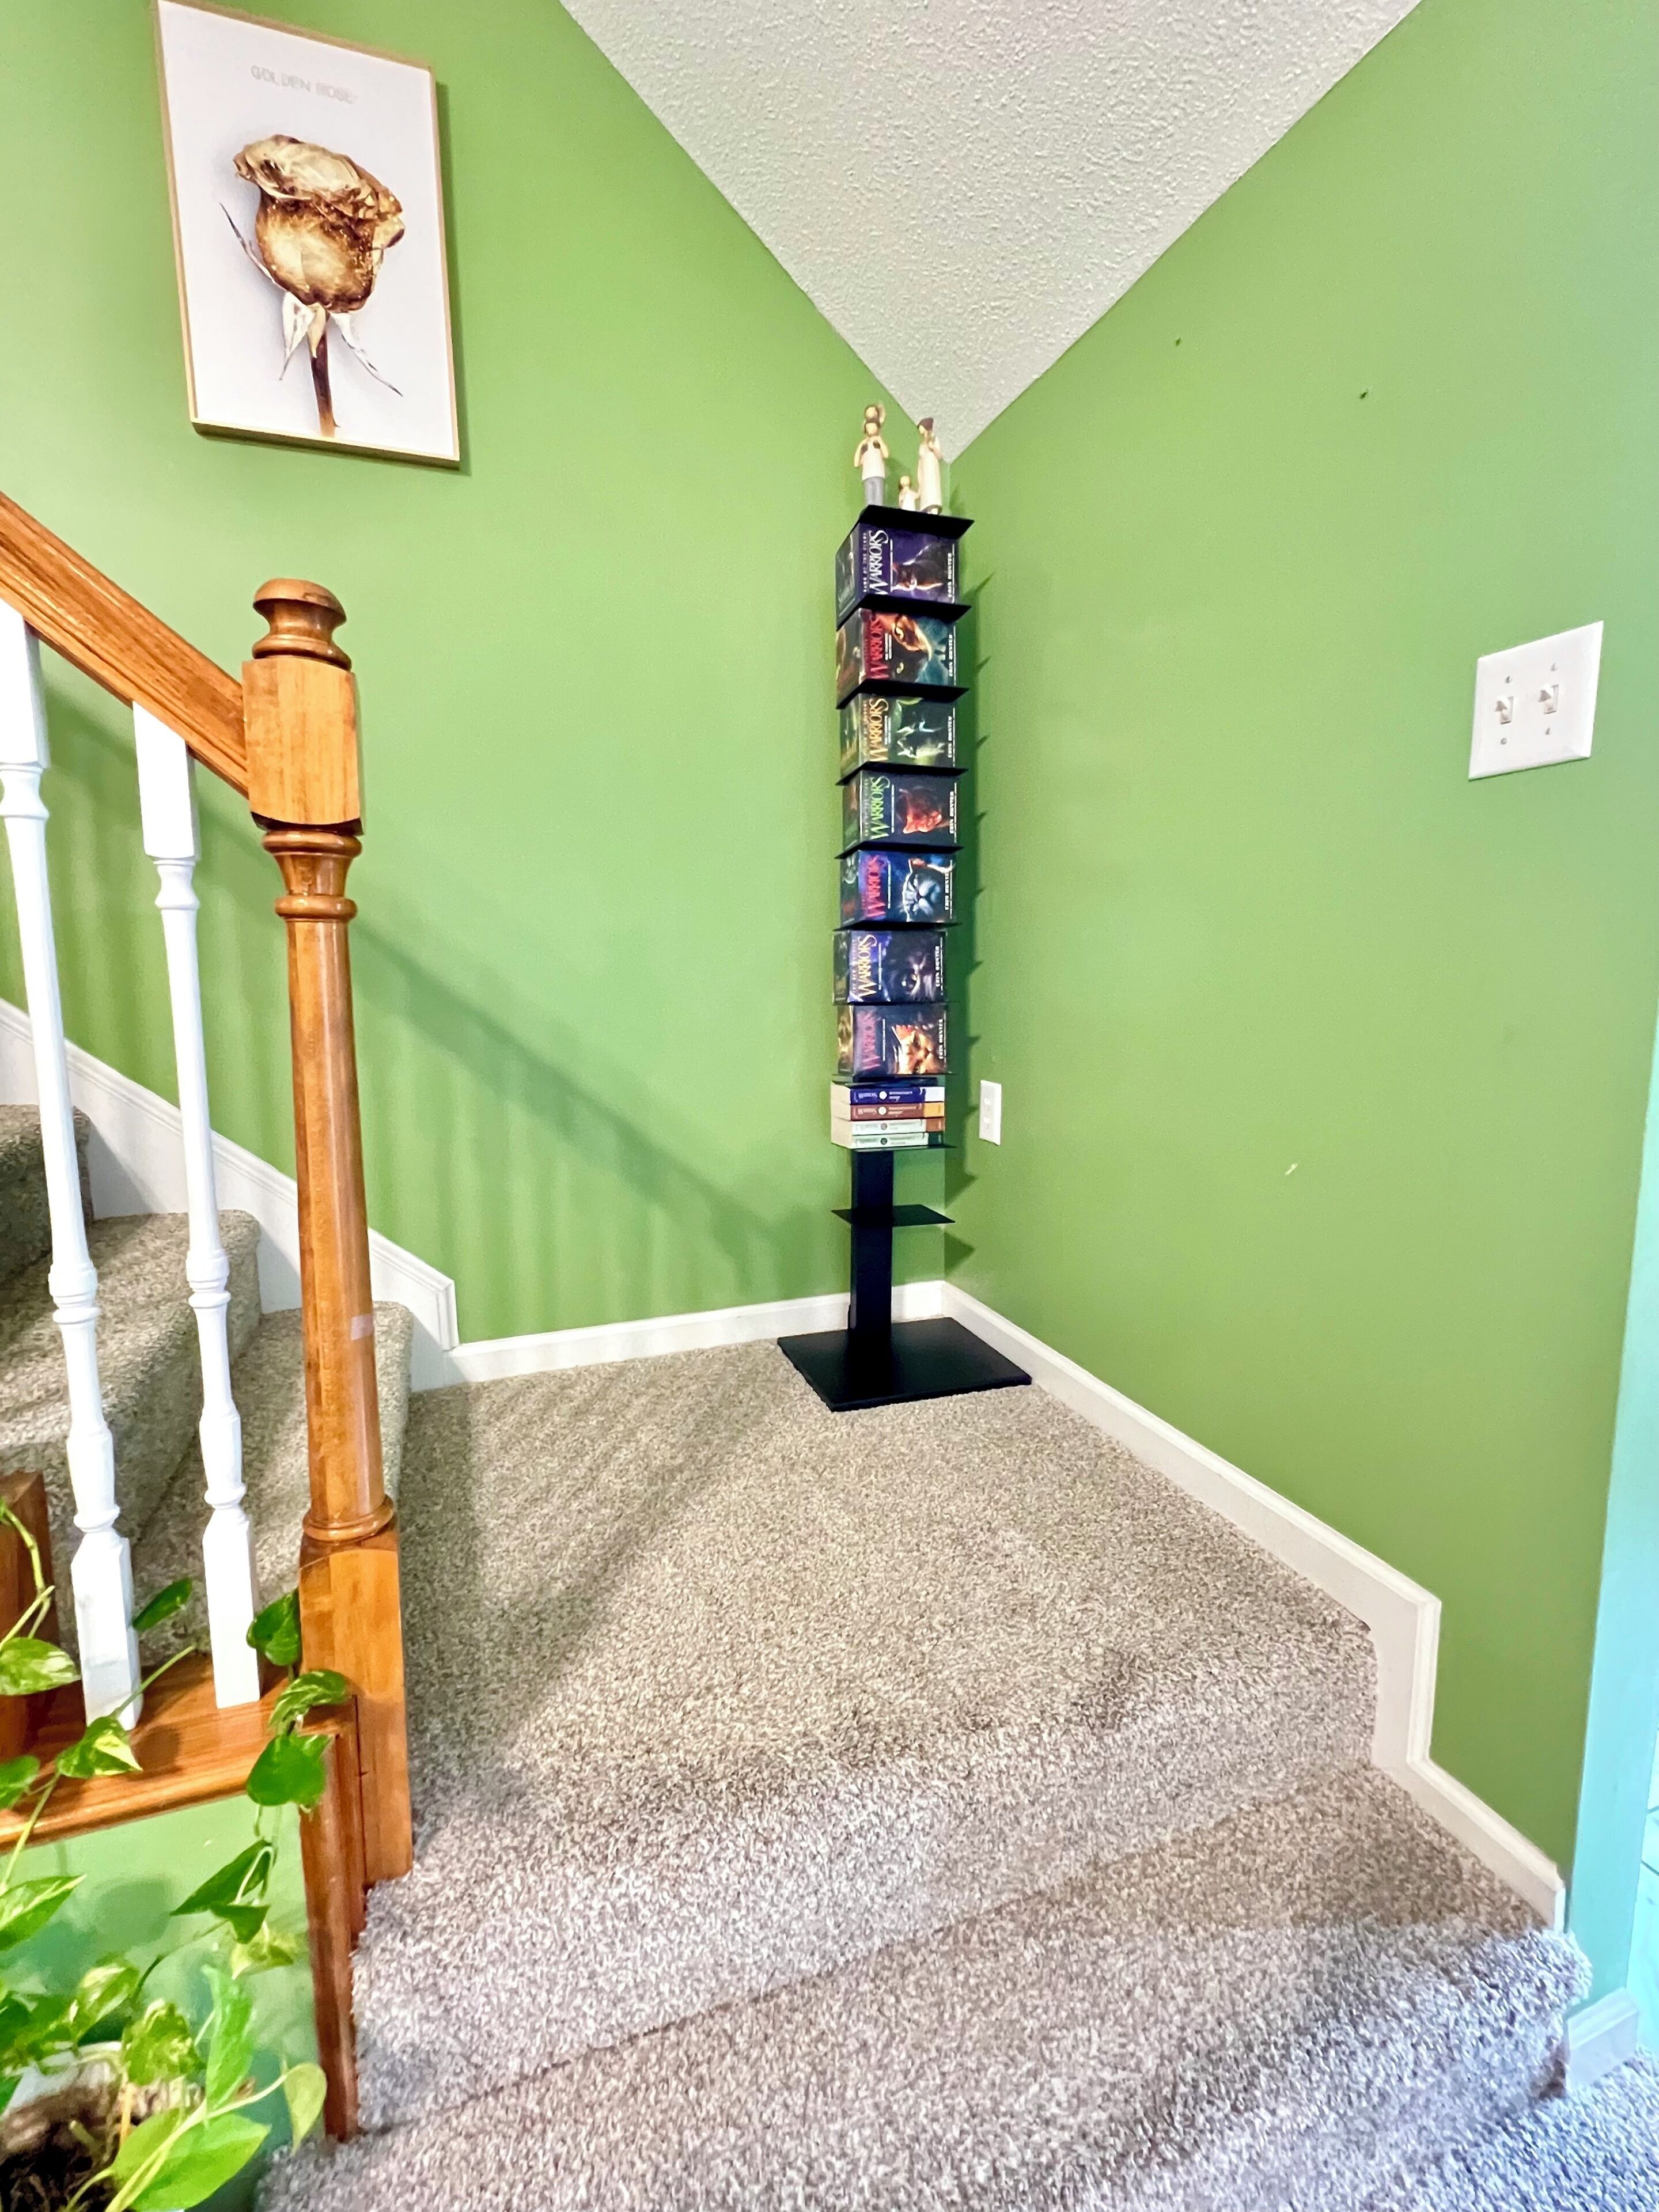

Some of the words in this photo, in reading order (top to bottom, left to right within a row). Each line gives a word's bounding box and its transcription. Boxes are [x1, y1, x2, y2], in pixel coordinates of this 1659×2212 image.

[251, 65, 310, 92] GOLDEN
[316, 82, 358, 104] ROSE
[869, 530, 888, 594] WARRIORS
[869, 698, 889, 762] WARRIORS
[870, 776, 890, 839] WARRIORS
[858, 934, 877, 997] WARRIORS
